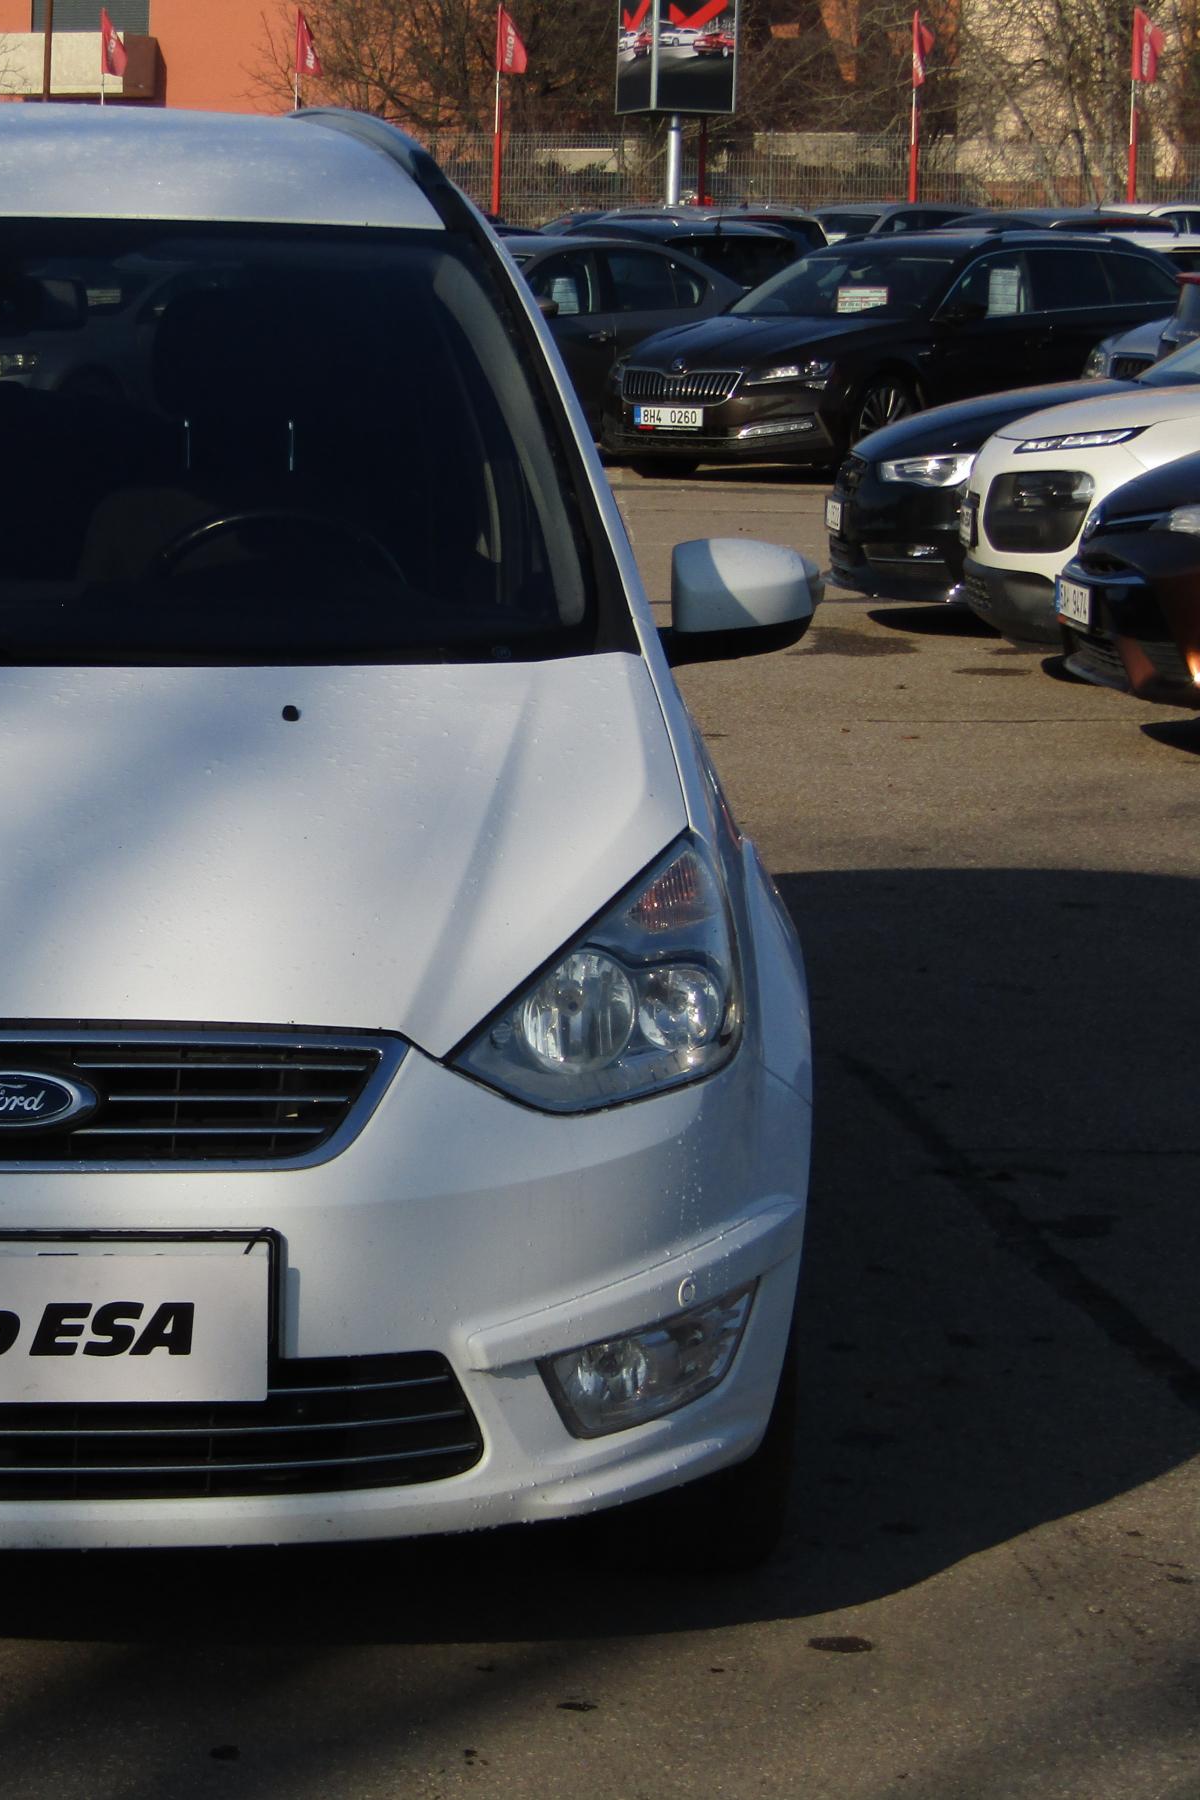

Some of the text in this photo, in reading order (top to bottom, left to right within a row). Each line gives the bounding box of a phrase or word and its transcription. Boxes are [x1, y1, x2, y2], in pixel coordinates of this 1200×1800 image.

[643, 409, 697, 424] 8H4 0260
[29, 1301, 195, 1356] ESA
